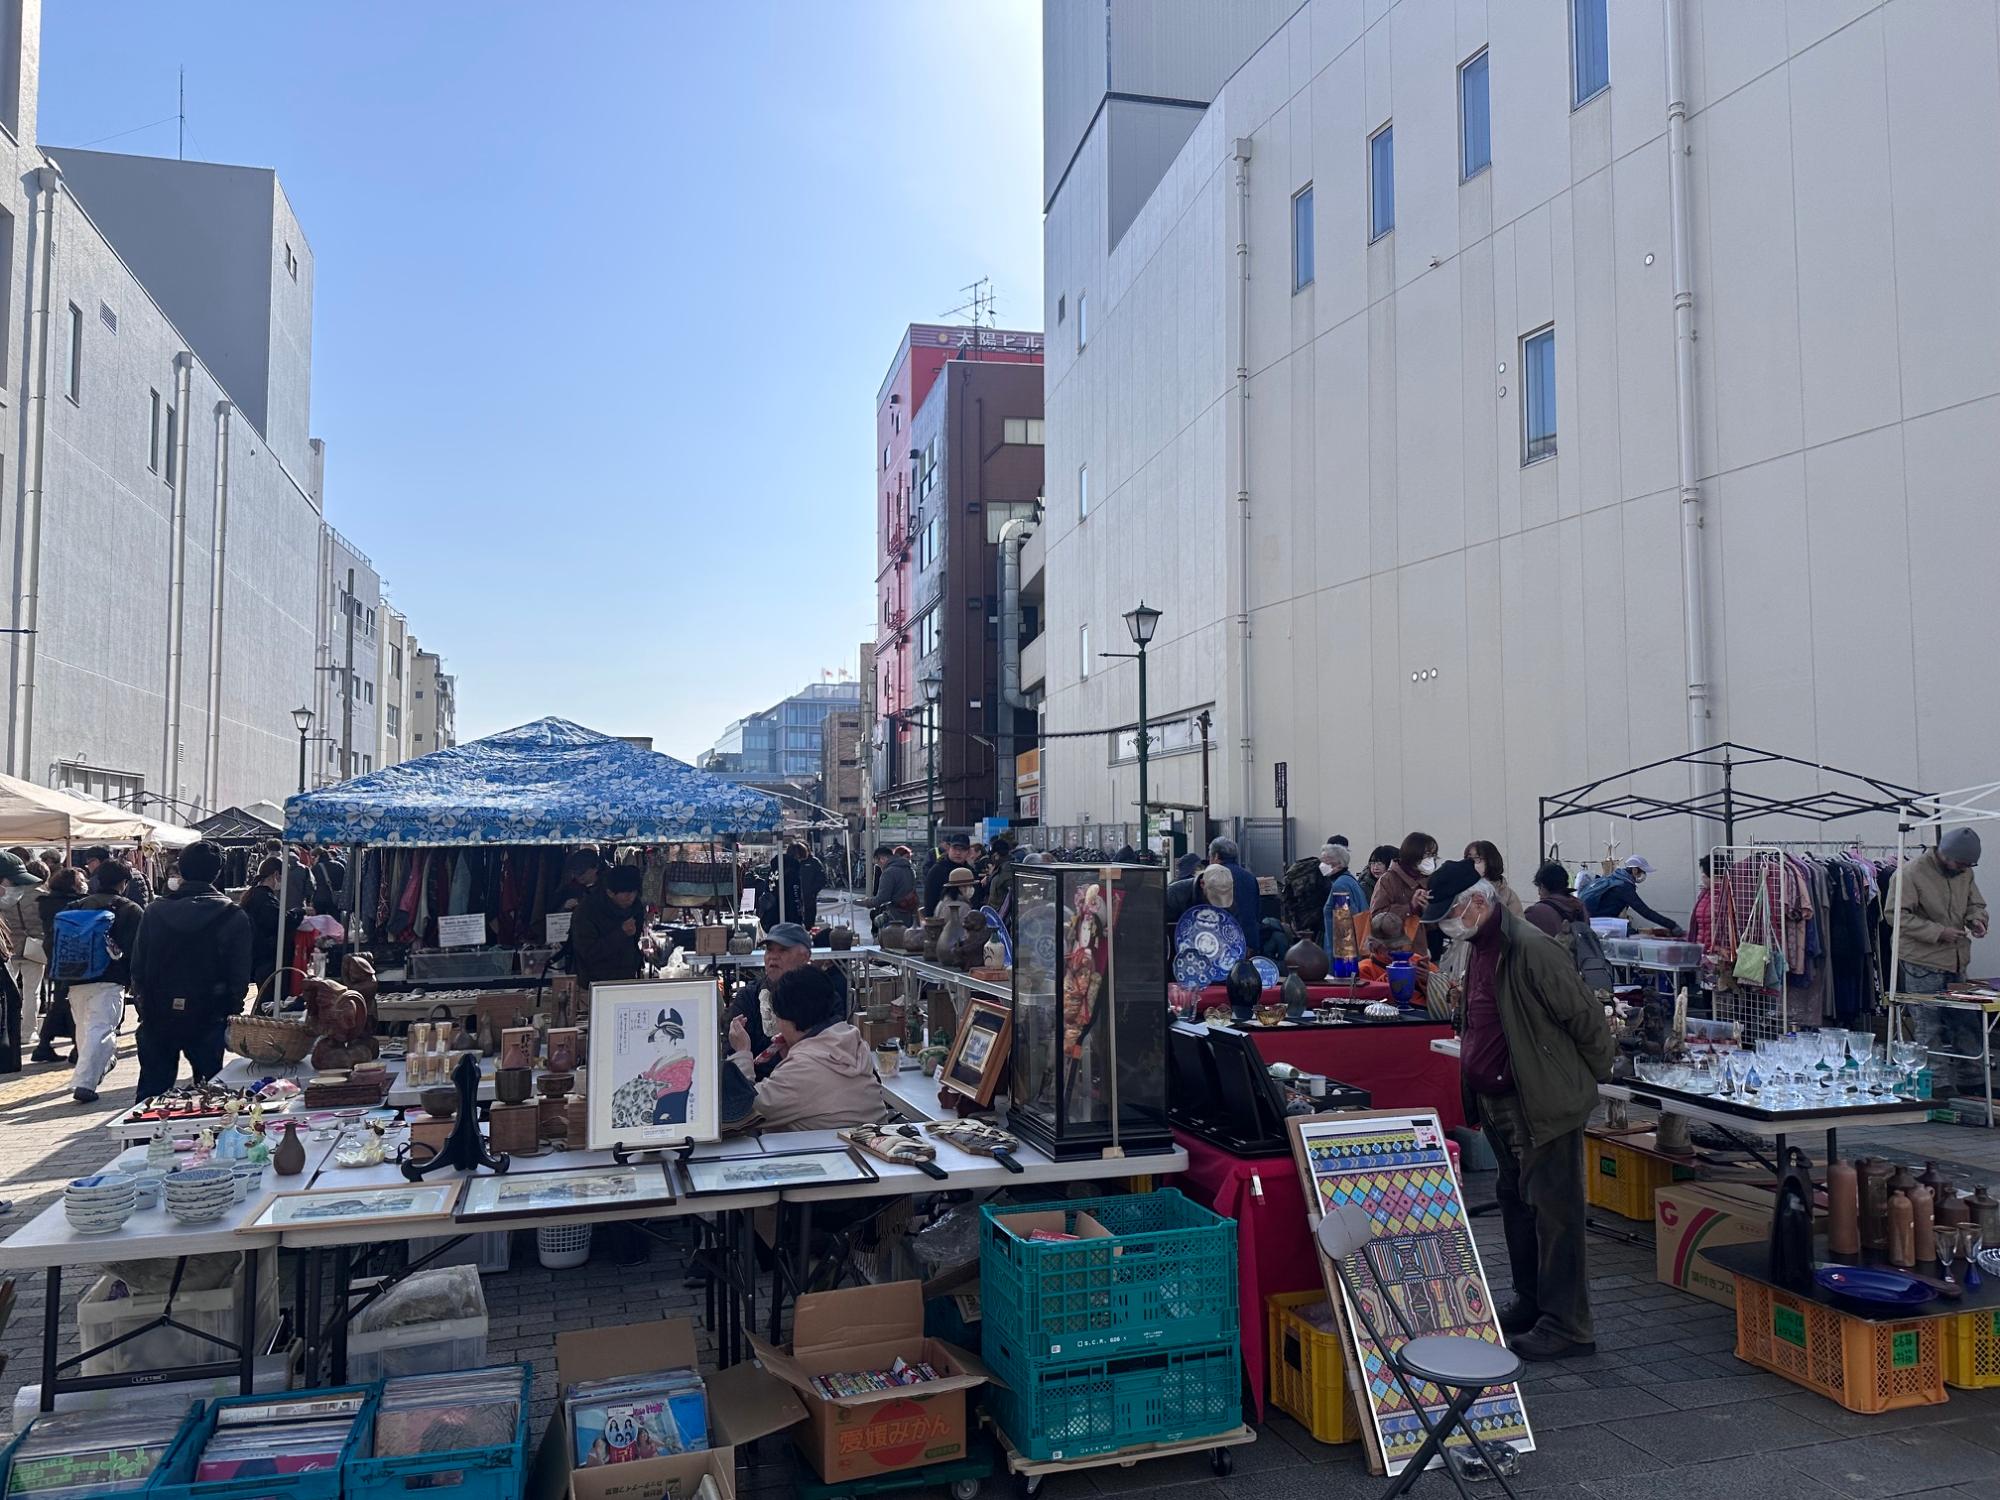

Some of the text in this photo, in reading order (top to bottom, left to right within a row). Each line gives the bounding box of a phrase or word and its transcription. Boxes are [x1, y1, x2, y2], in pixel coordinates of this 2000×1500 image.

[956, 330, 1041, 352] 太陽ビル
[879, 813, 888, 823] P
[839, 1412, 951, 1454] 愛媛みかん
